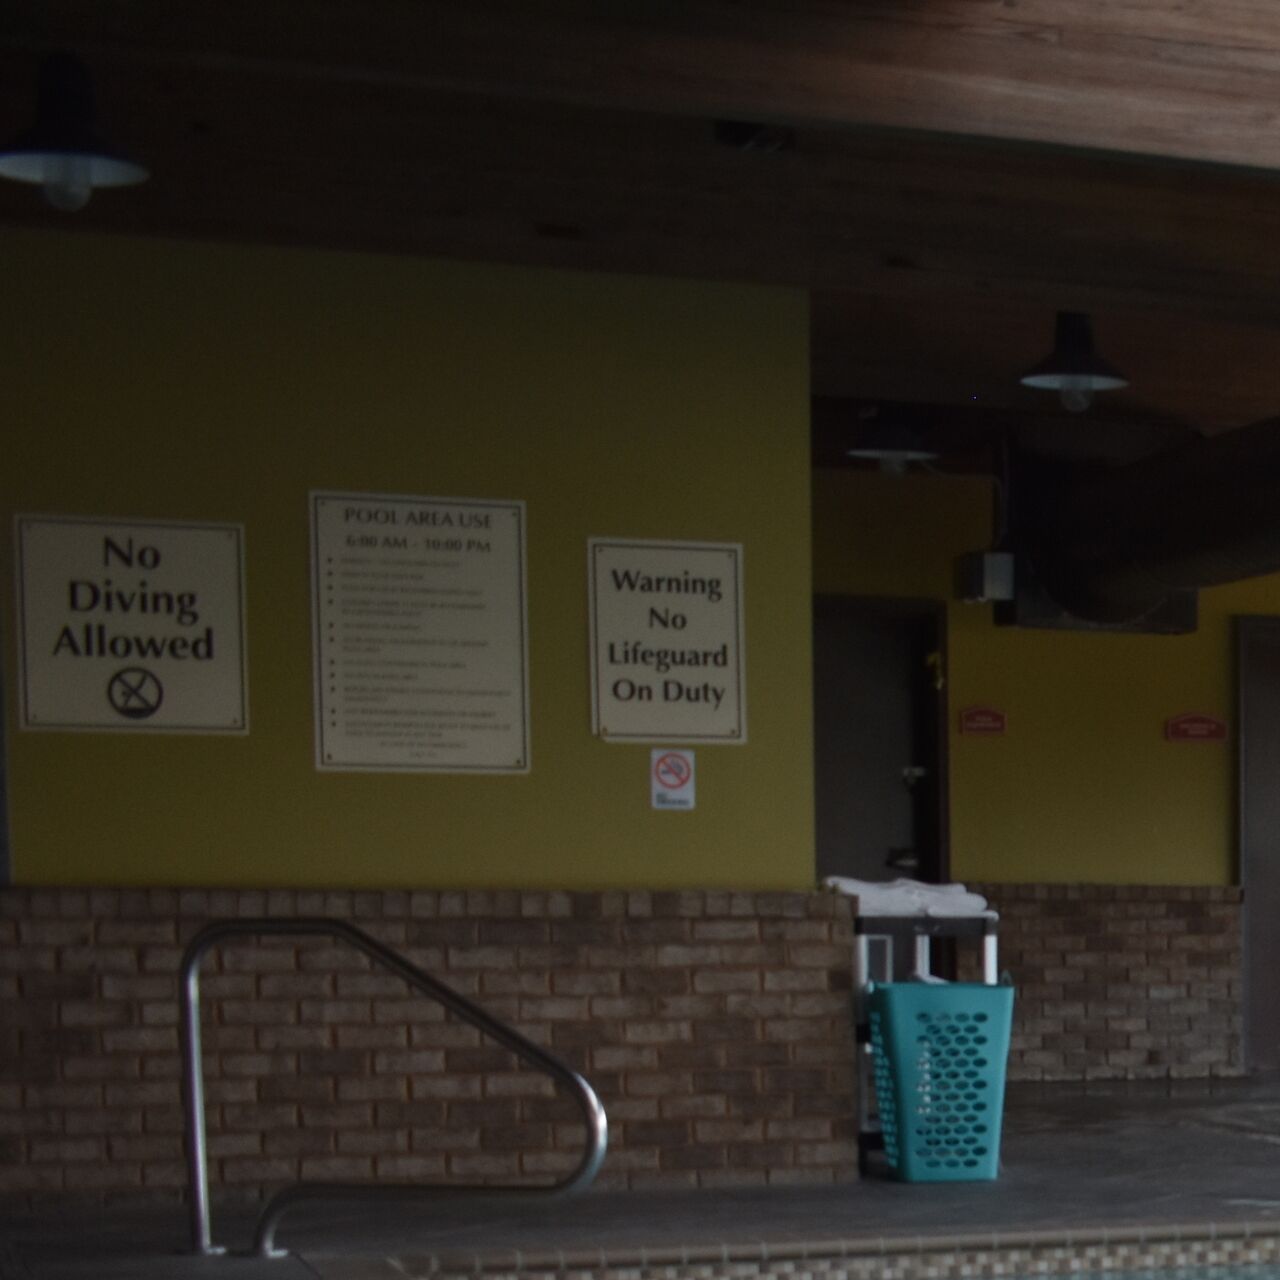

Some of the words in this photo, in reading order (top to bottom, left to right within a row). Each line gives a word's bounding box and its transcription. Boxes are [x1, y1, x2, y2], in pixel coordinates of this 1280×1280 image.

[344, 508, 399, 525] POOL
[405, 511, 454, 527] AREA
[459, 513, 492, 529] USE
[104, 537, 161, 569] No
[382, 536, 408, 549] AM
[425, 537, 462, 552] 10:00
[466, 538, 491, 553] PM
[611, 569, 722, 602] Warning
[69, 580, 199, 625] Diving
[649, 608, 687, 630] No
[52, 623, 214, 660] Allowed
[609, 641, 728, 673] Lifeguard
[612, 679, 652, 702] On
[664, 679, 725, 711] Duty
